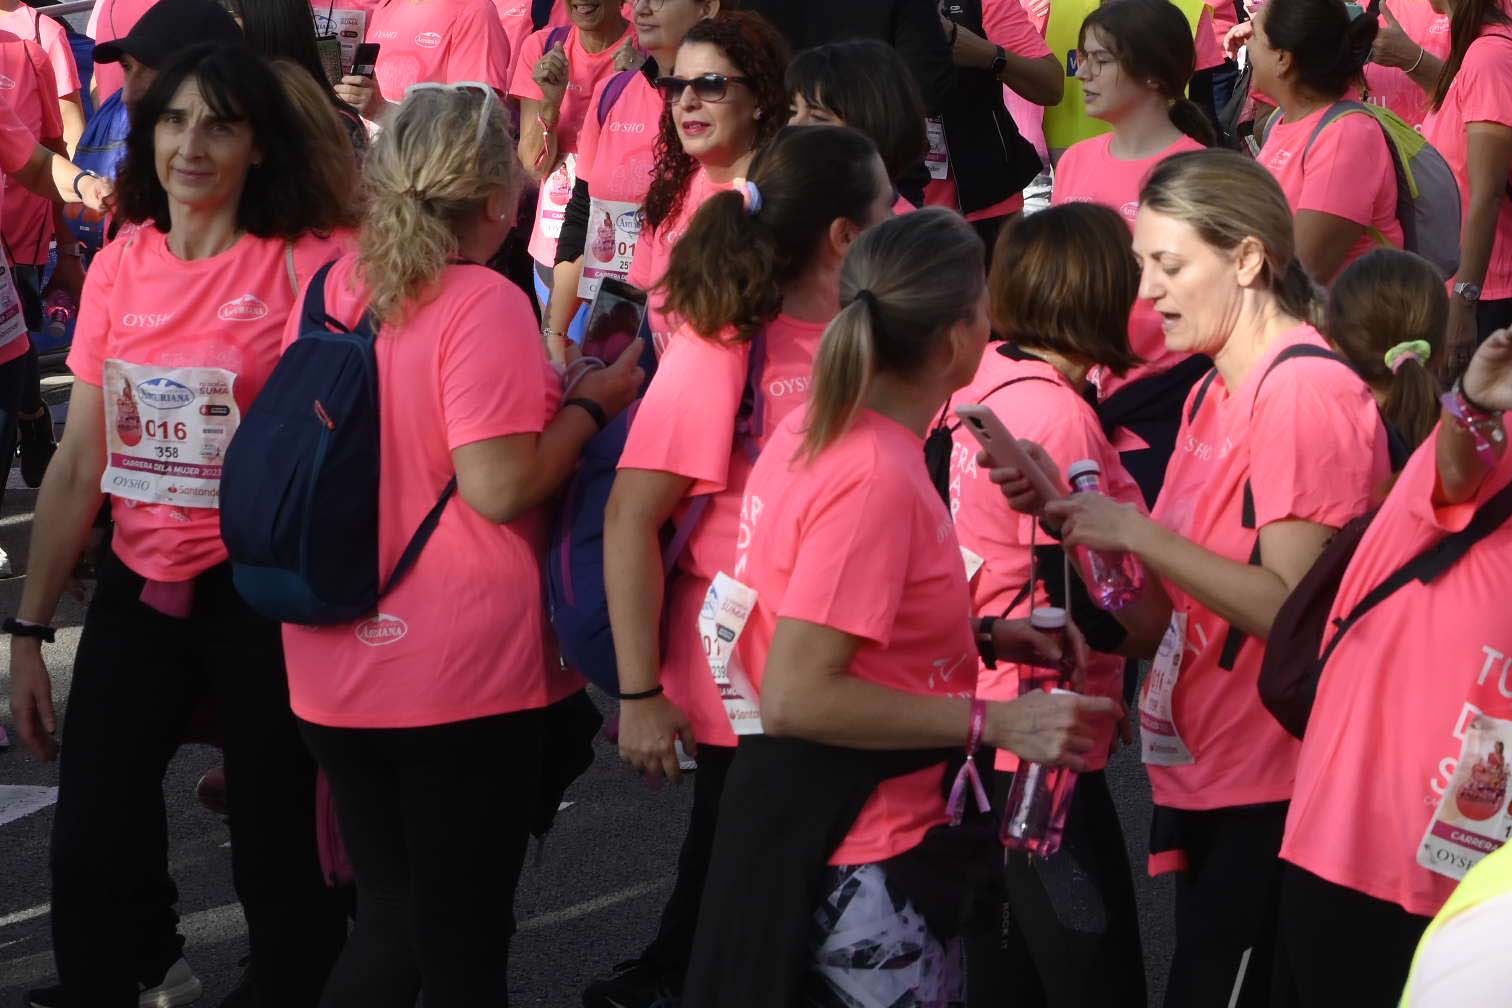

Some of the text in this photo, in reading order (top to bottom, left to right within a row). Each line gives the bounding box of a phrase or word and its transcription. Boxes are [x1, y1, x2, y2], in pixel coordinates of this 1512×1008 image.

[146, 419, 187, 441] 016
[173, 465, 200, 474] MUJER
[112, 474, 149, 491] OYSHO
